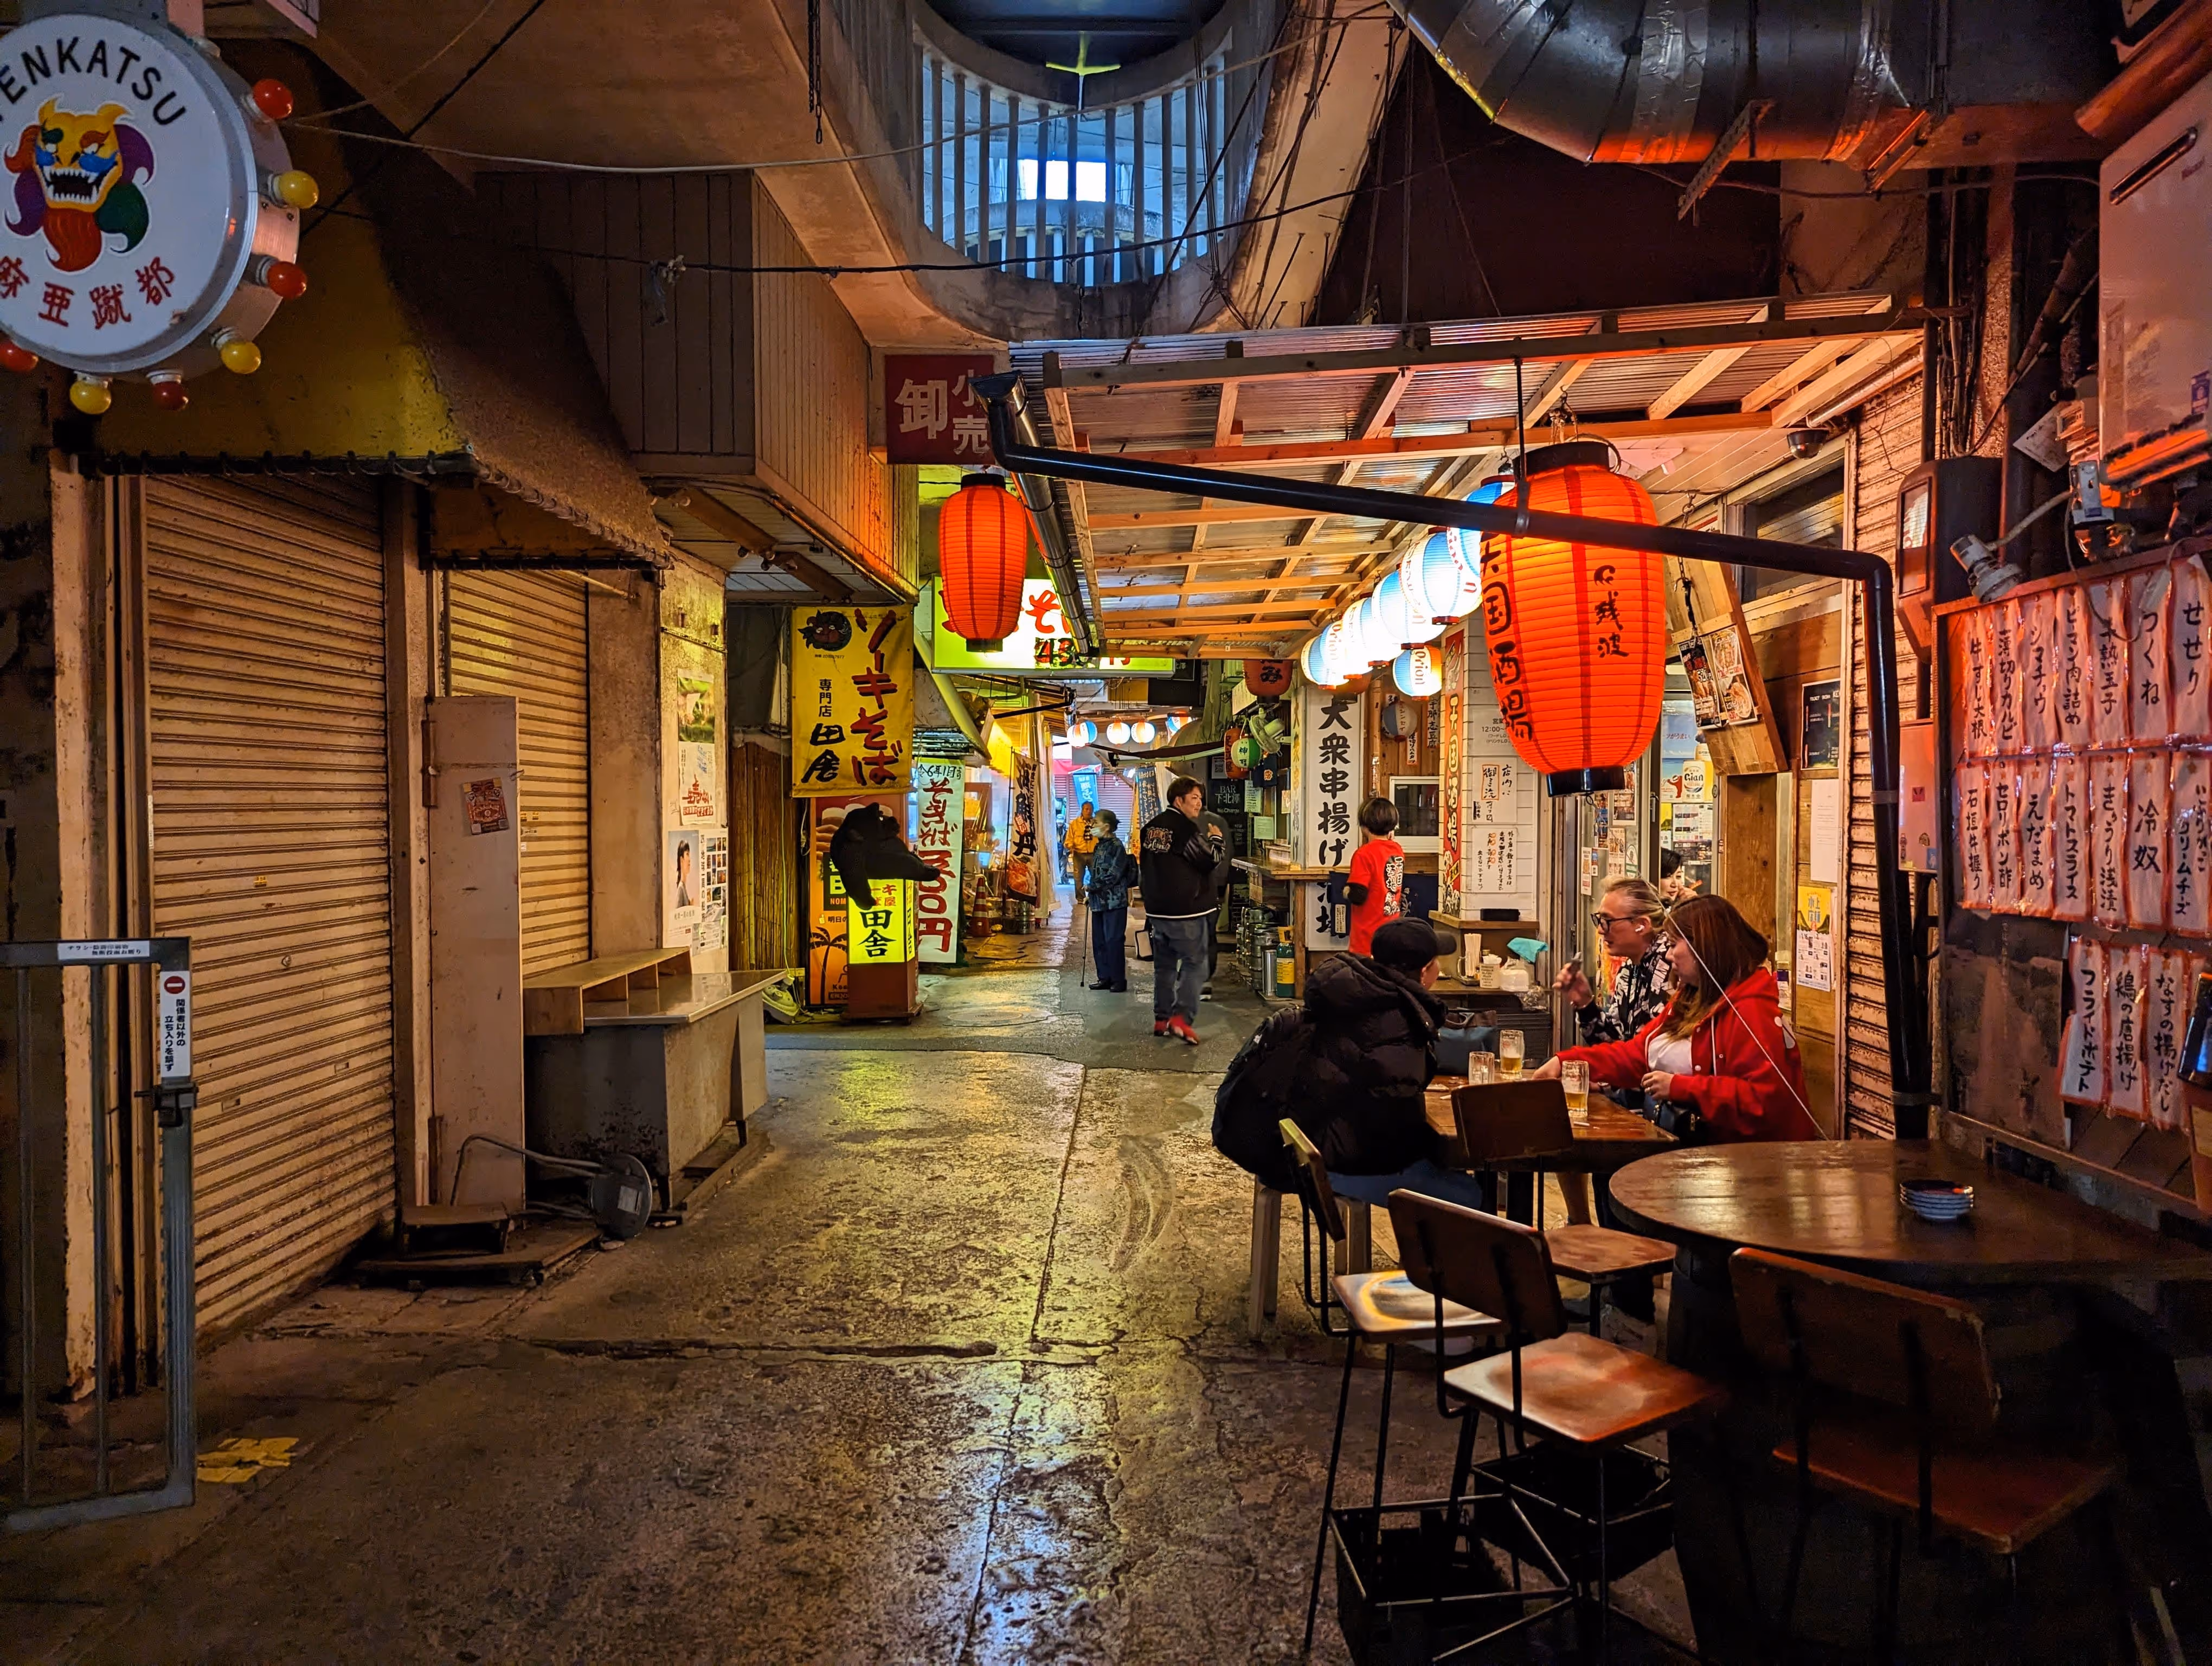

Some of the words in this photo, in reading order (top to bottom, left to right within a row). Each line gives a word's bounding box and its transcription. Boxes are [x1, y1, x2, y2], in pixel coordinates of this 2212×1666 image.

[0, 36, 187, 125] ENKATSU
[895, 378, 948, 440] 卸
[1413, 650, 1429, 685] Orion
[1594, 591, 1629, 658] 残波
[2029, 626, 2047, 714] シマチョウ
[2062, 606, 2081, 726] ピーマン肉詰め
[2099, 617, 2119, 715] 半熟玉子
[2140, 611, 2160, 706] つくね
[2182, 600, 2204, 696] せせり
[818, 678, 833, 718] 専門店
[850, 607, 903, 786] ソーキそば
[1970, 638, 1988, 740] 牛すじ大根
[1998, 629, 2017, 741] 薄切りカルビ
[1220, 785, 1237, 793] BAR
[1317, 696, 1351, 868] 大衆串揚げ
[1447, 694, 1460, 853] 天国酒場
[1966, 788, 1983, 890] 石垣牛握り
[1995, 781, 2012, 889] セロリポン酢
[2025, 793, 2045, 890] えだまめ
[2064, 784, 2079, 899] トマトスライス
[2099, 782, 2118, 912] きゅうり浅漬
[2132, 798, 2162, 873] 冷奴
[2175, 820, 2191, 915] クリームチーズ
[857, 909, 897, 958] 田舎
[870, 884, 897, 895] ーキ
[874, 896, 897, 907] ば屋
[164, 1015, 174, 1072] 立ち入りを禁ず
[176, 998, 186, 1047] 関係者以外の
[2078, 969, 2099, 1093] フライドポテト
[2114, 971, 2138, 1092] 鶏の唐揚げ
[2155, 975, 2177, 1111] なすの揚げだし
